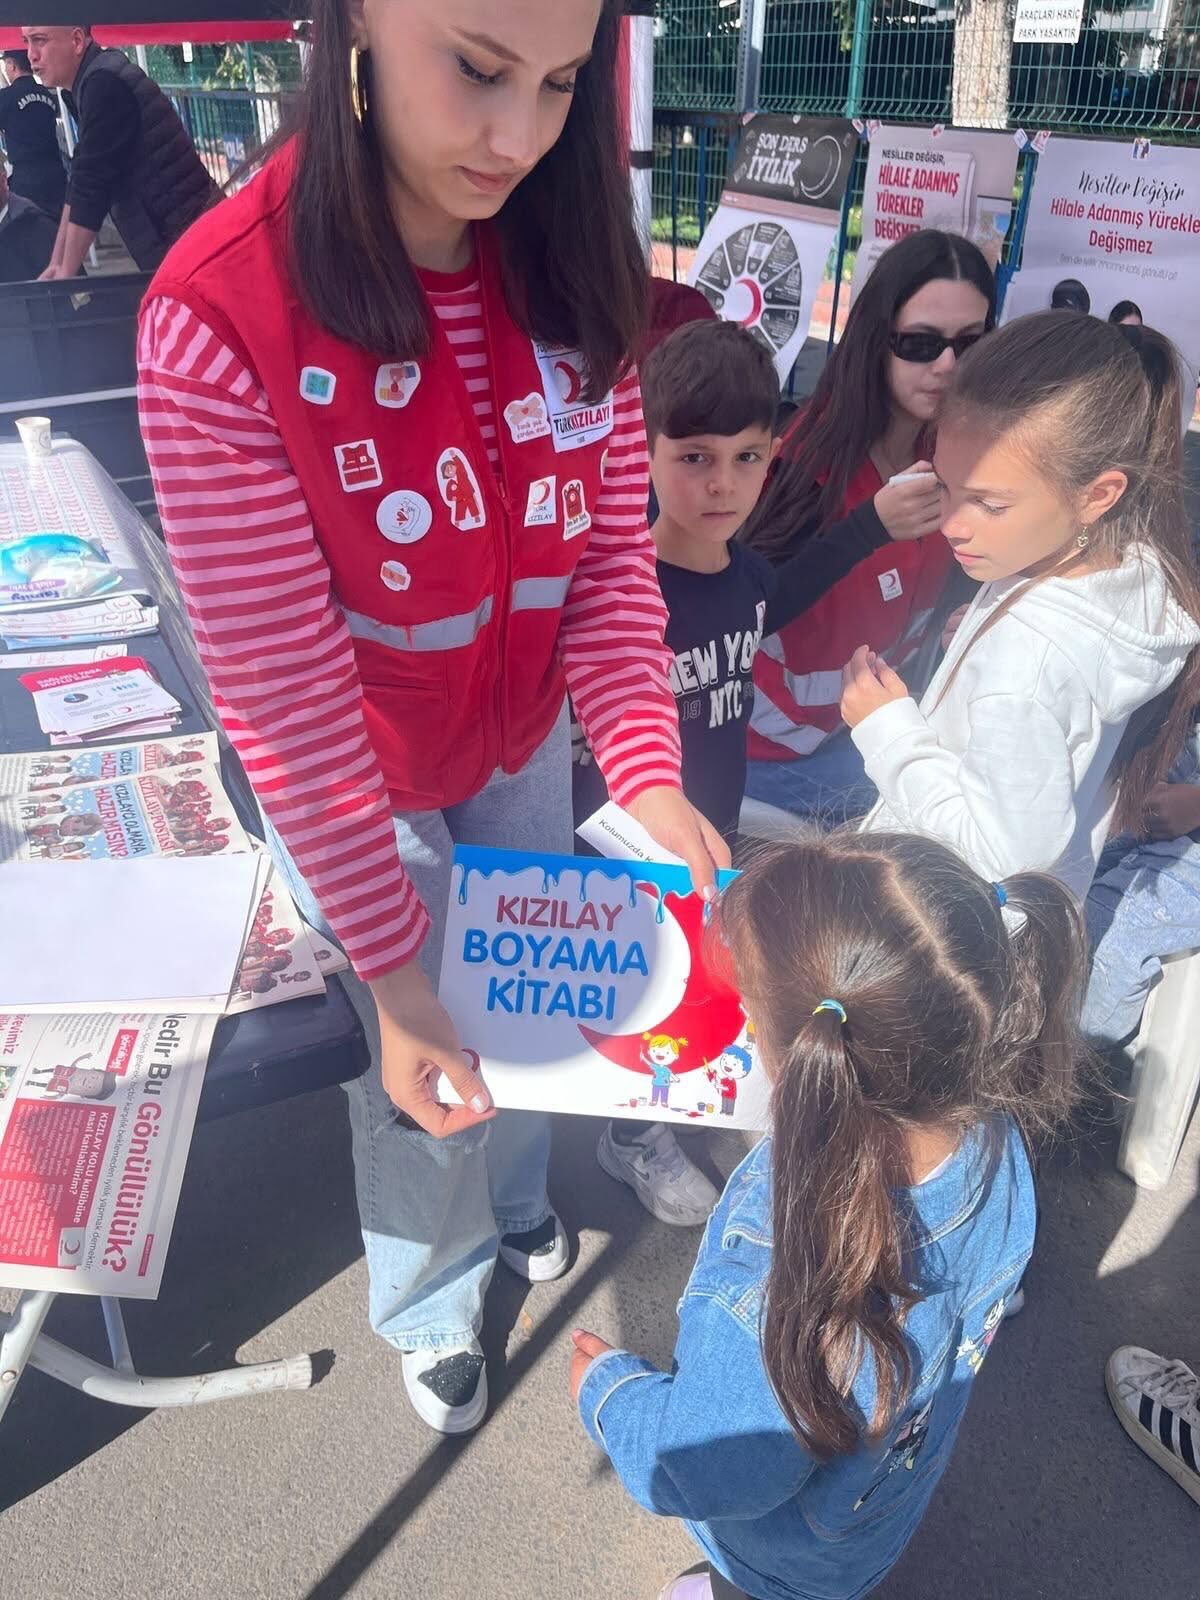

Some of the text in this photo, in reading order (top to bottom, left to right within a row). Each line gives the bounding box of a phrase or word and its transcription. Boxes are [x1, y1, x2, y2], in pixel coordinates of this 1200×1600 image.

[757, 133, 809, 154] SON DERS
[881, 147, 914, 162] NESİLLER
[878, 161, 960, 197] HİLALE ADANMIŞ
[876, 189, 924, 219] YÜREKLER
[1050, 198, 1085, 218] Hilale
[1086, 202, 1144, 229] Adanmış
[1089, 229, 1153, 254] Değişmez
[709, 679, 743, 729] NYC
[95, 785, 117, 819] HAZIR
[598, 818, 644, 858] Kolumuzda
[496, 895, 623, 931] KIZILAY
[463, 928, 649, 976] BOYAMA
[487, 969, 616, 1020] KİTABI
[143, 1063, 172, 1095] Bu
[83, 1110, 97, 1133] nasıl
[73, 1111, 109, 1224] KIZILAY KOLU kulübüne
[101, 1101, 162, 1273] Gönüllülük?
